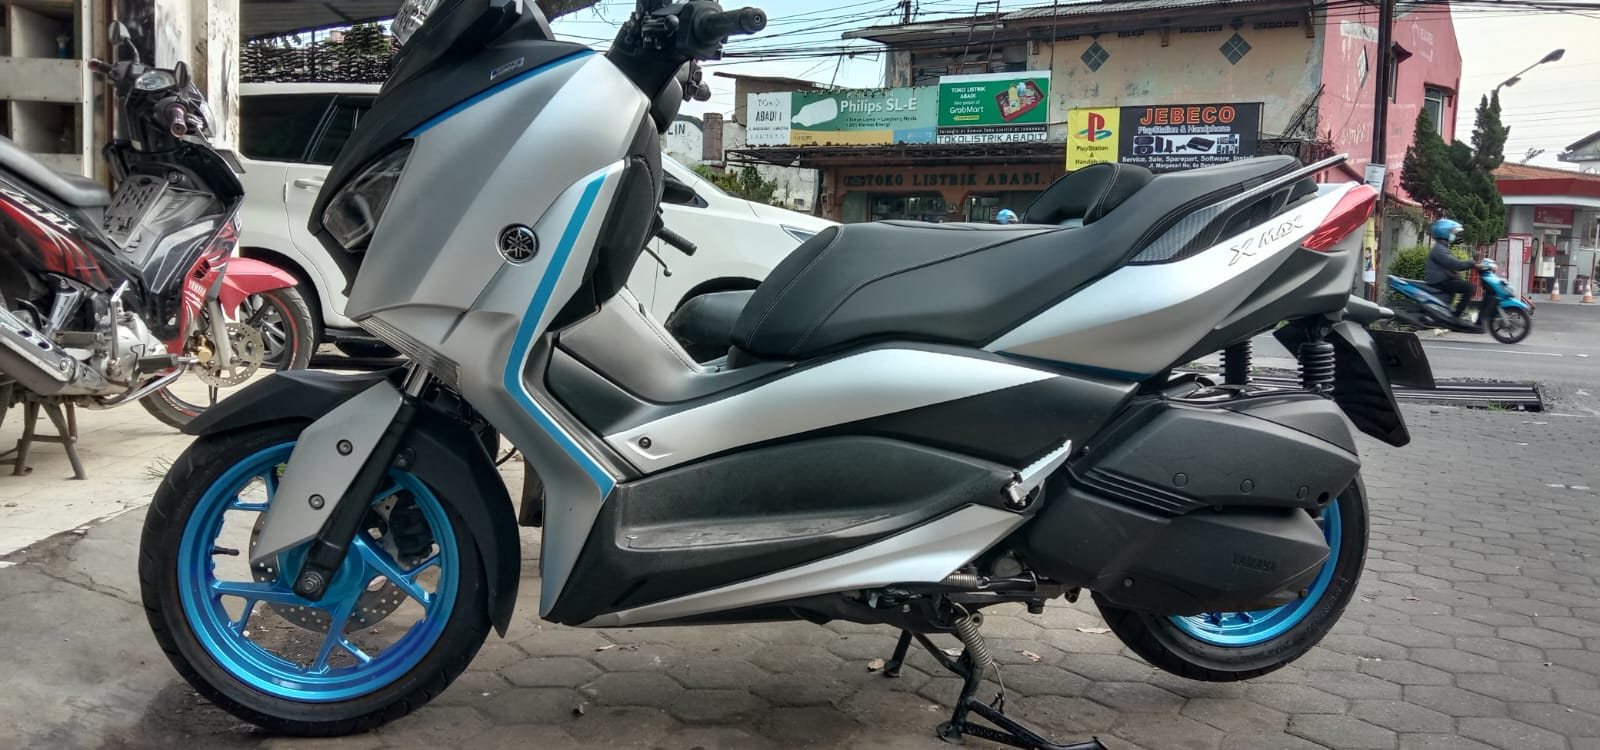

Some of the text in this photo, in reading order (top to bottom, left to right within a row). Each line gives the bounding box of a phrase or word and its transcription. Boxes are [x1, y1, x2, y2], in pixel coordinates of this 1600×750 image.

[841, 97, 918, 114] Philips SL-E
[950, 106, 984, 114] GrabMart
[756, 111, 777, 121] ABADI
[1140, 105, 1236, 125] JEBECO
[1187, 124, 1231, 135] Handphone
[866, 174, 904, 186] TOKO
[912, 173, 977, 186] LISTRIK
